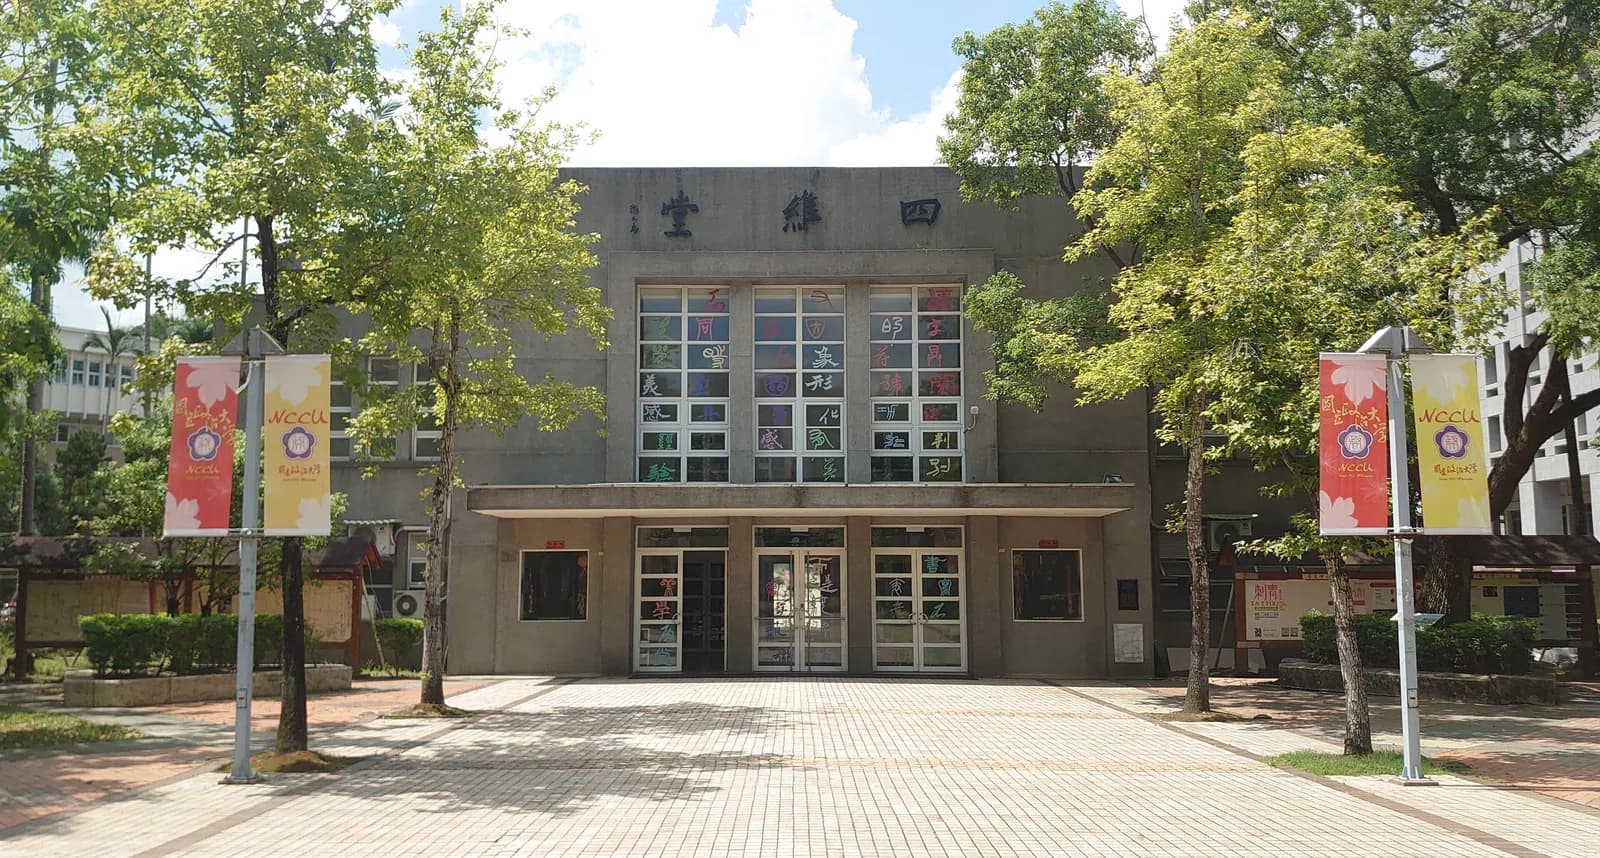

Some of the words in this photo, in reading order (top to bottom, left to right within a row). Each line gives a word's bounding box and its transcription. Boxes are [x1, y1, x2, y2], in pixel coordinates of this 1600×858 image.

[268, 408, 329, 425] NCCU
[1321, 394, 1386, 443] 國立政治大學
[1418, 408, 1481, 424] NCCU
[185, 464, 221, 474] NCCU
[1338, 463, 1375, 472] NCCU
